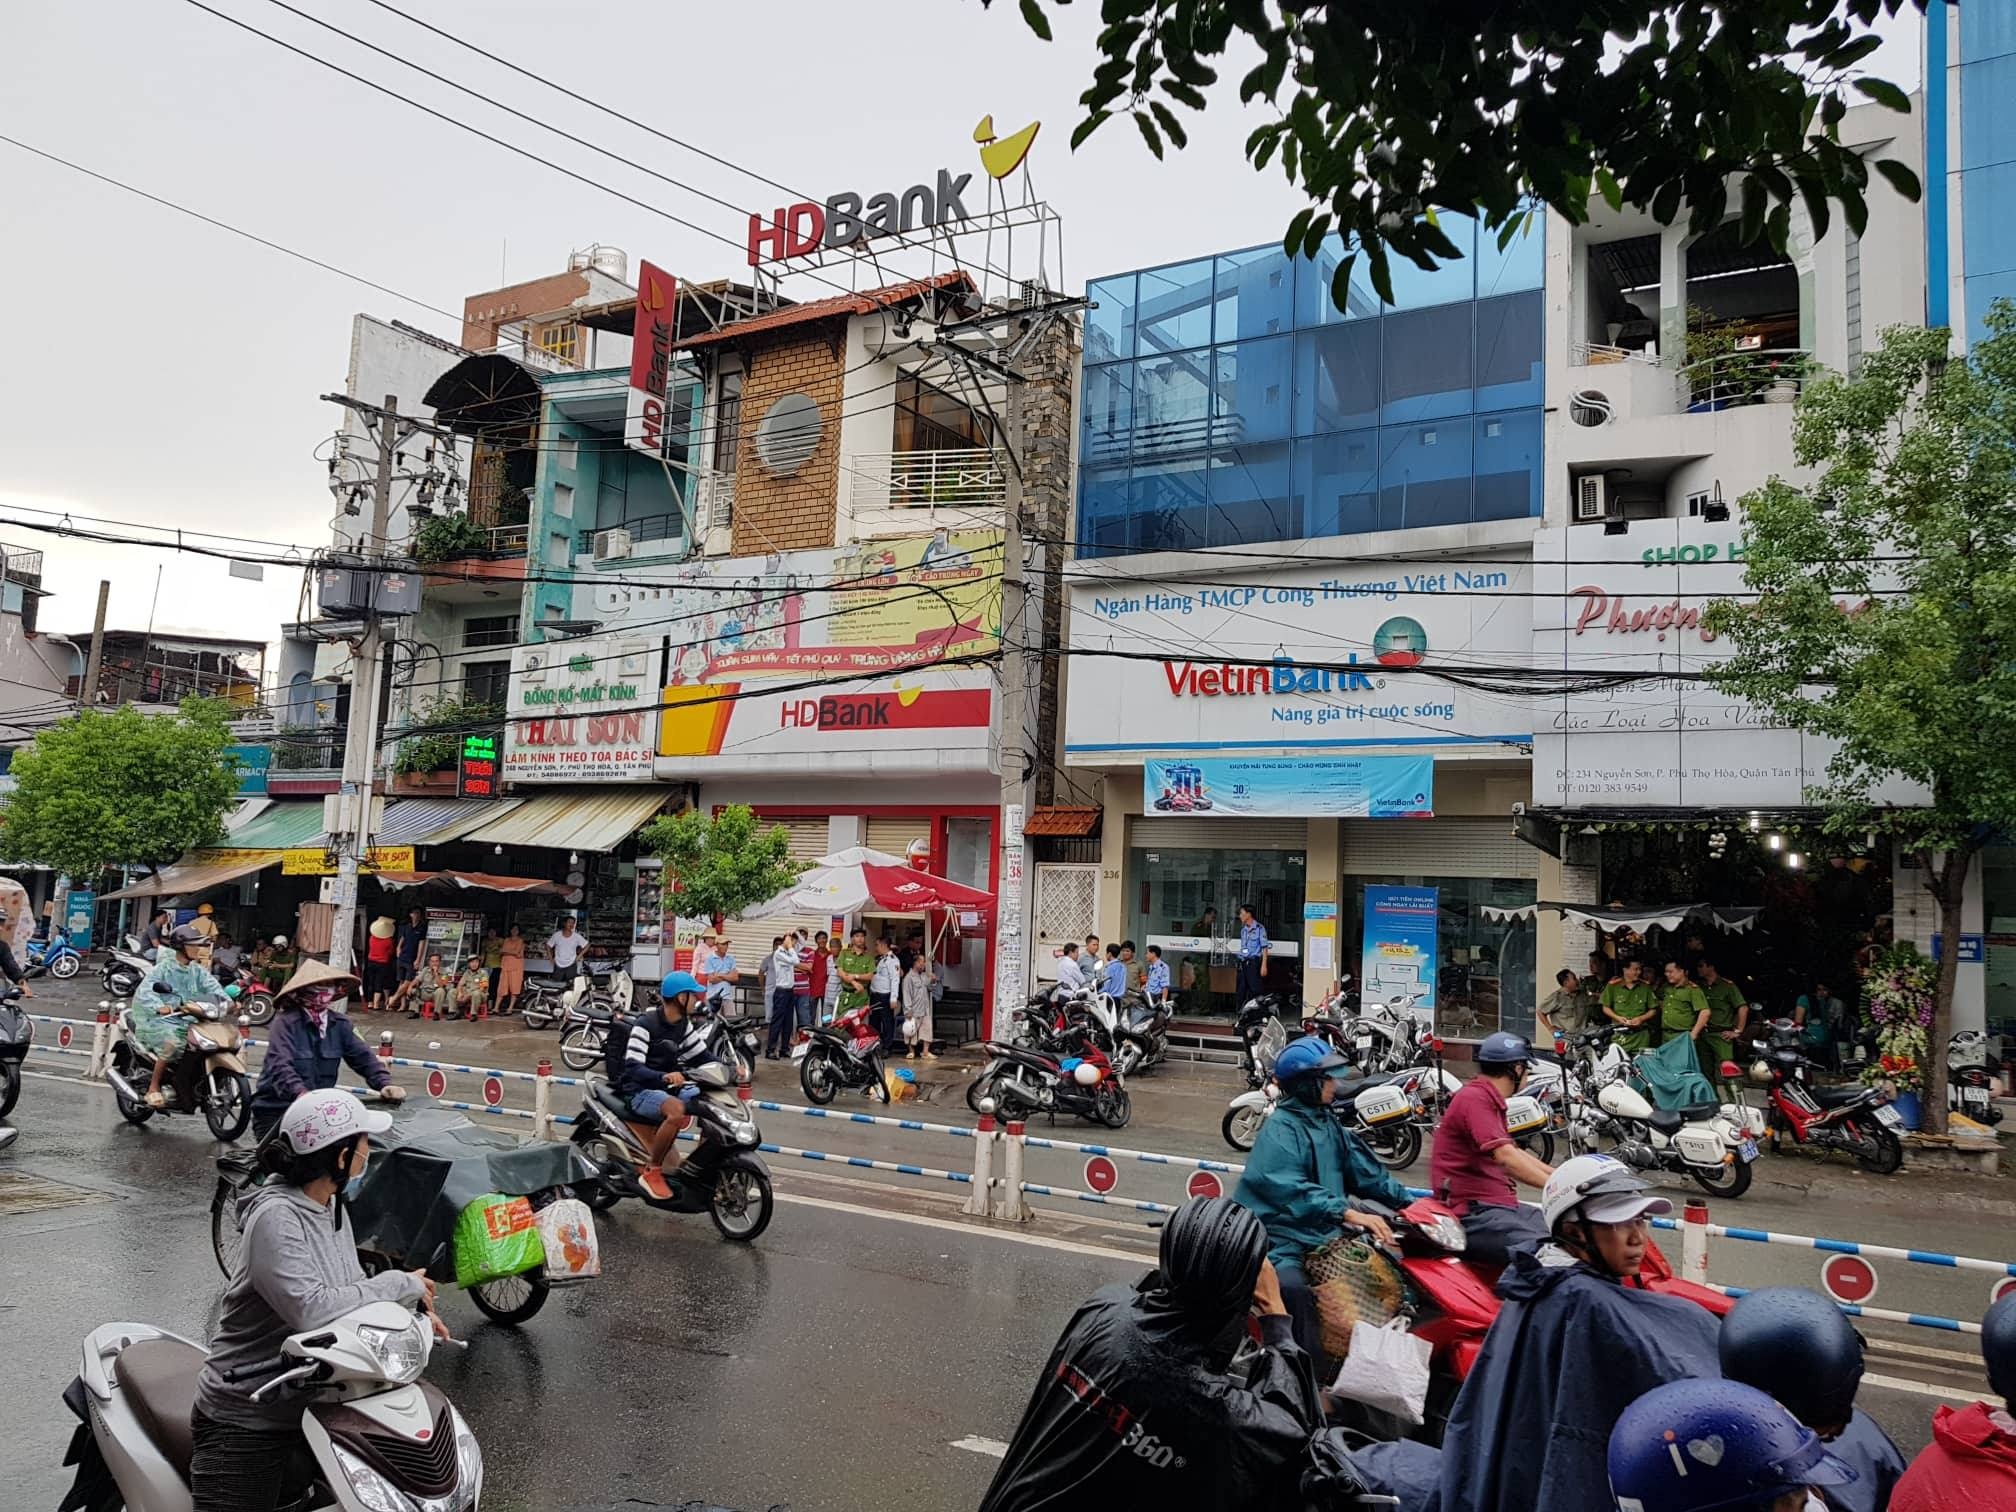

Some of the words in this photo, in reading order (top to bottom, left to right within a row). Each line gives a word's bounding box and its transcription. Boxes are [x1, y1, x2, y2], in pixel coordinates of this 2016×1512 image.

[748, 168, 972, 266] HDBank
[640, 319, 672, 450] HDBank
[1642, 544, 1719, 568] SHOP
[1728, 543, 1750, 561] H
[1094, 597, 1140, 619] Ngân
[1145, 593, 1193, 615] Hàng
[1198, 588, 1256, 608] TMCP
[1454, 570, 1507, 590] Nam
[1162, 653, 1374, 697] VietinBank
[780, 698, 890, 730] HDBank
[1271, 706, 1313, 724] Nâng
[1317, 704, 1341, 722] giá
[1346, 704, 1364, 722] trị
[1369, 704, 1408, 719] cuộc
[1414, 702, 1454, 720] sống
[1553, 711, 1589, 730] Các
[1600, 709, 1647, 732] Loại
[1658, 707, 1711, 729] Hoa
[560, 752, 587, 762] THEO
[592, 751, 611, 761] TOA
[615, 748, 638, 761] BÁC
[1366, 1102, 1393, 1115] CSTT
[1508, 1114, 1529, 1126] STT
[1121, 1422, 1174, 1469] 360
